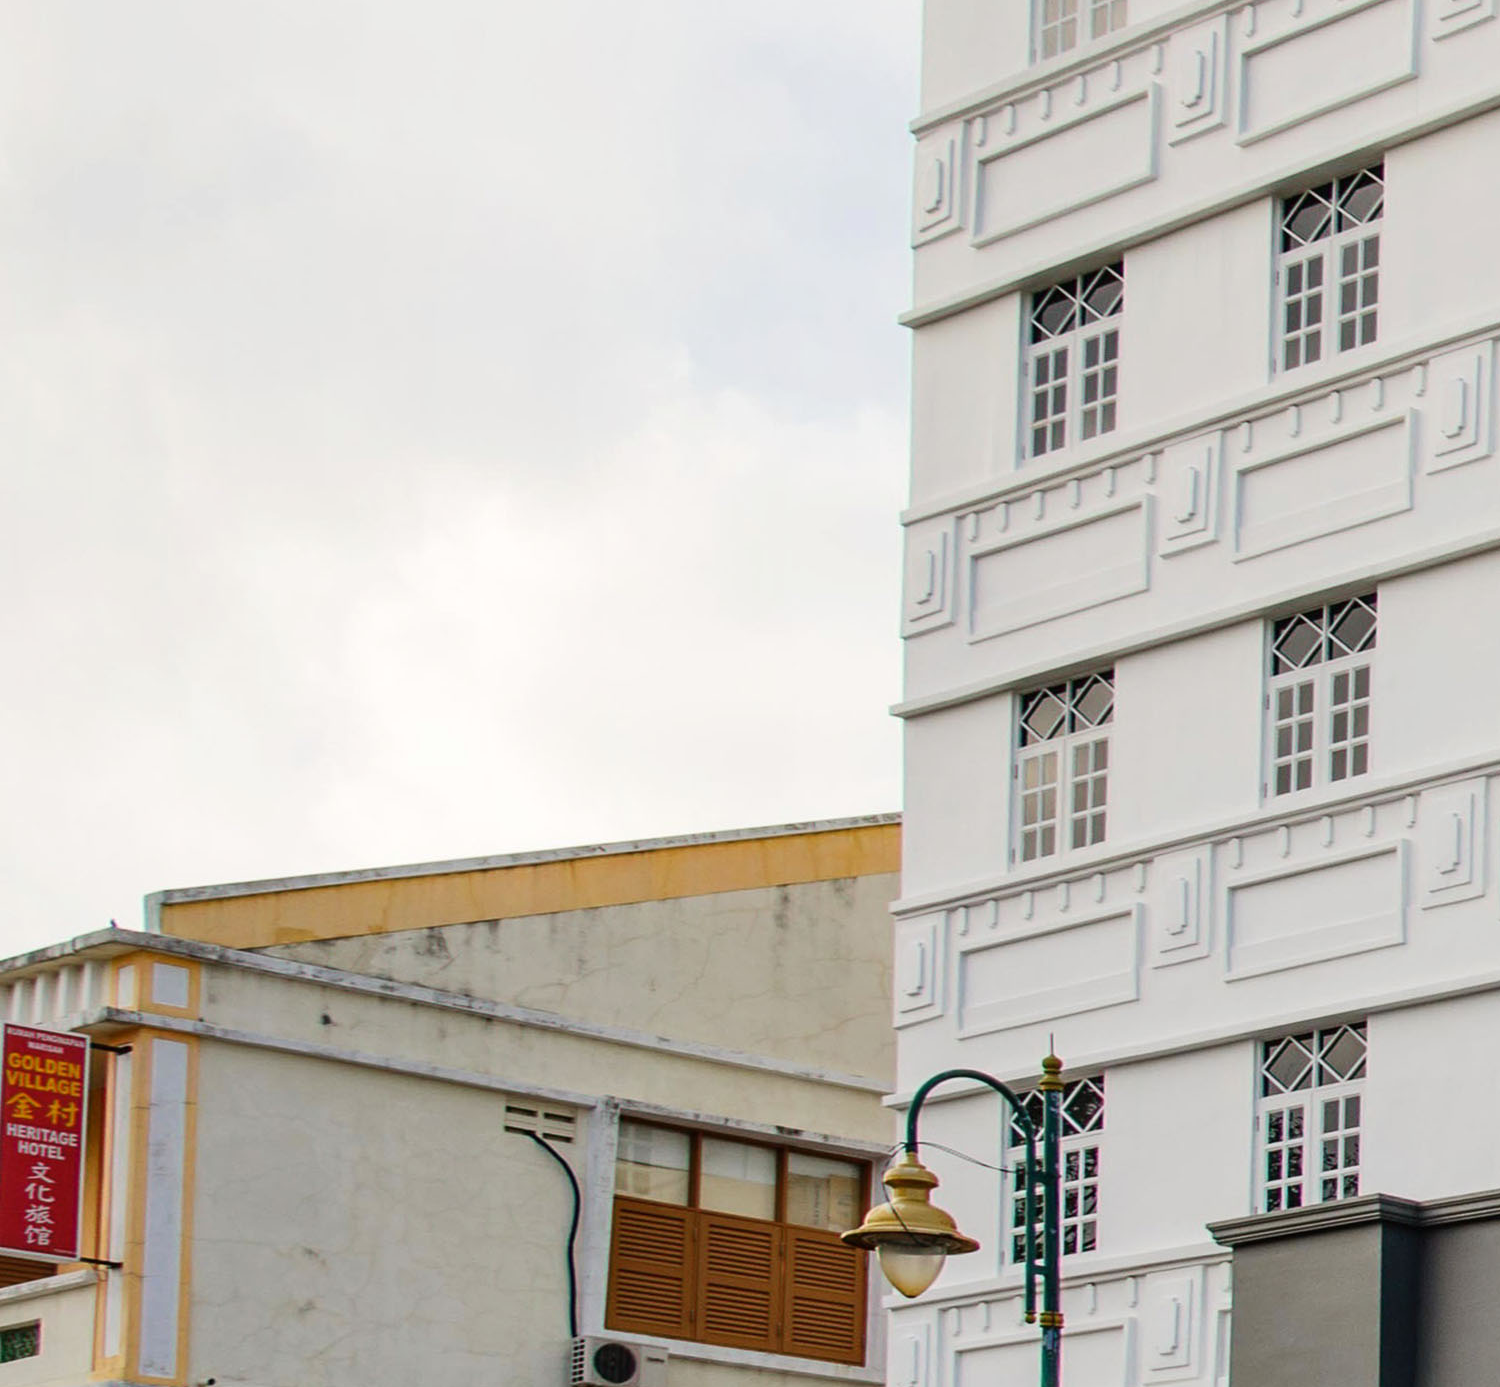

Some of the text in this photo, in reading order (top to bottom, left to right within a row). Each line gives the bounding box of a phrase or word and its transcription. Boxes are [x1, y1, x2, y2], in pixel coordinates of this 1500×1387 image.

[8, 1052, 81, 1079] GOLDEN
[5, 1069, 81, 1097] VILLAGE
[6, 1092, 79, 1127] 金村
[6, 1122, 79, 1147] HERITAGE
[18, 1140, 66, 1161] HOTEL
[23, 1161, 57, 1246] 文化旅馆
